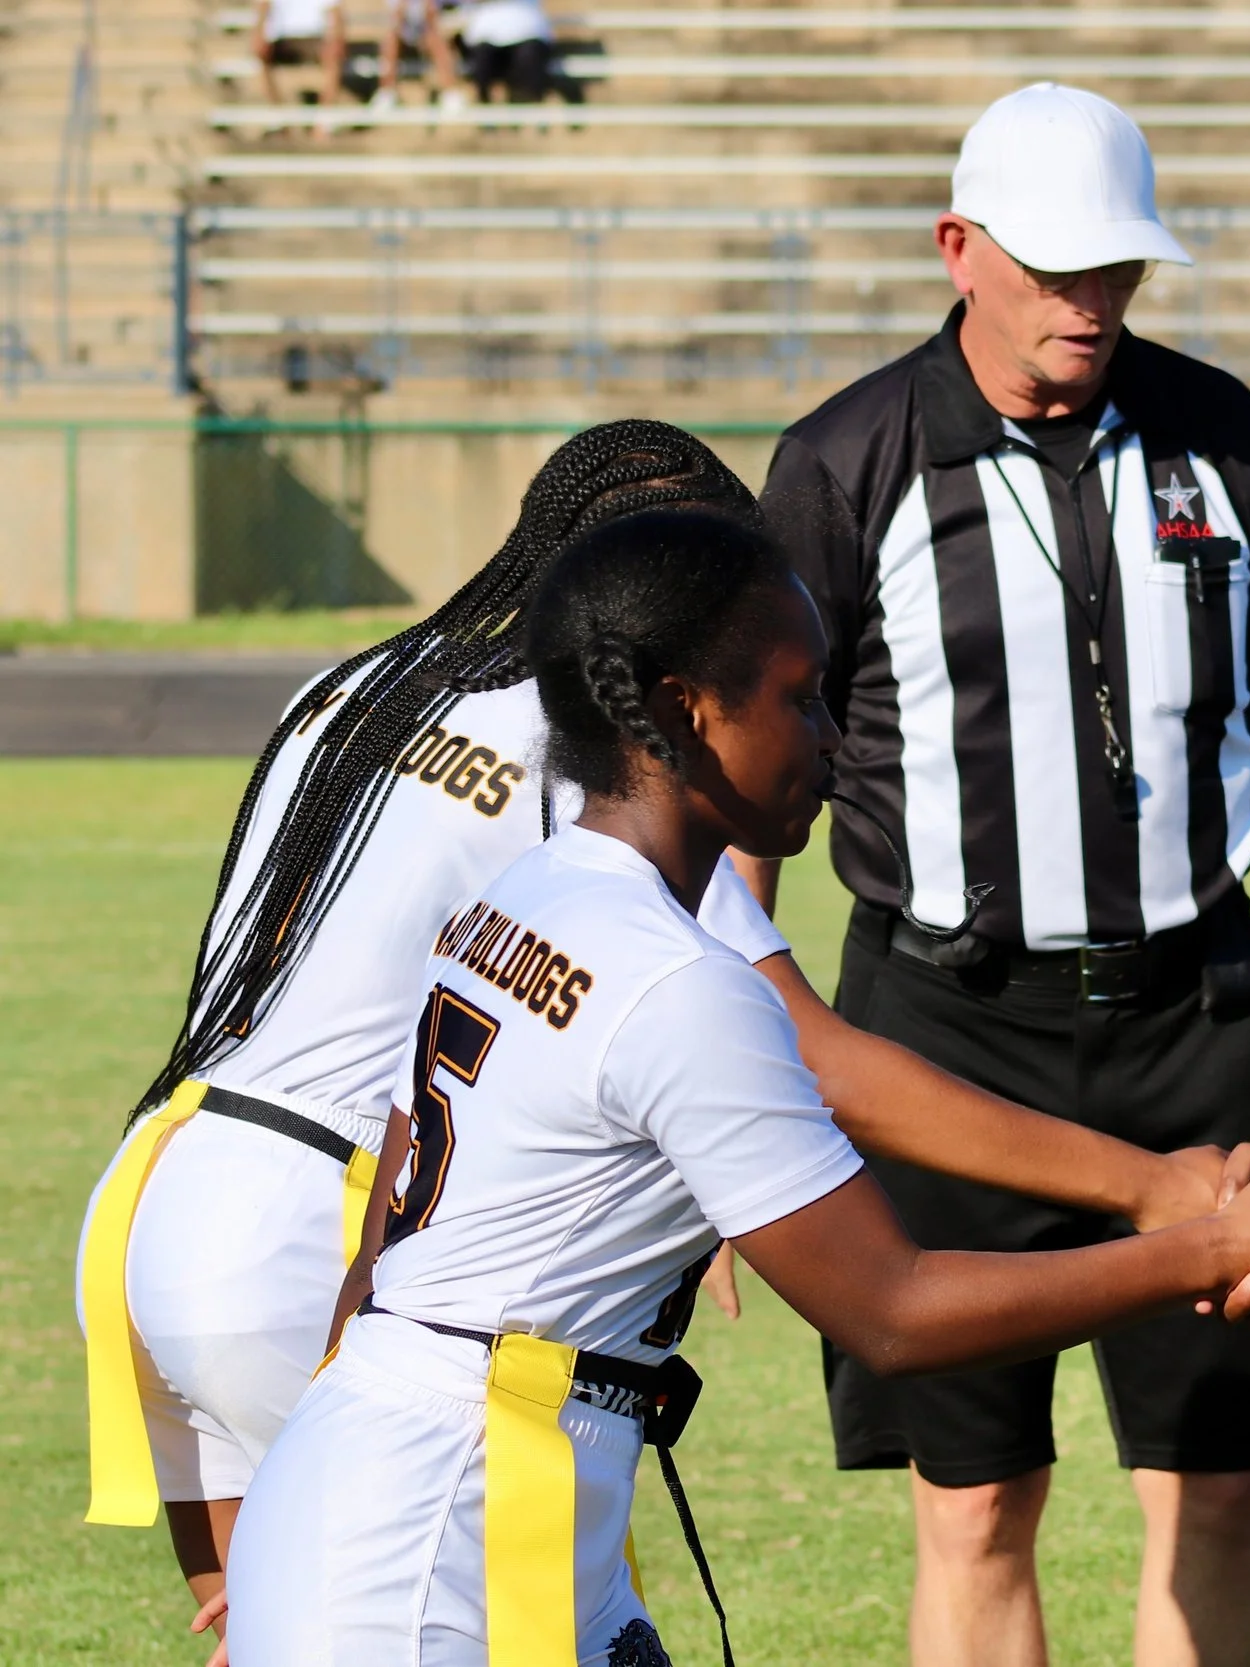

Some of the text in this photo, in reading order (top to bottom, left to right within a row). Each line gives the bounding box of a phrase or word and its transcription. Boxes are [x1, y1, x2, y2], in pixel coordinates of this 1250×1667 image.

[1156, 521, 1215, 539] AHSAA
[396, 725, 527, 819] DOGS
[458, 908, 594, 1031] BULLDOGS
